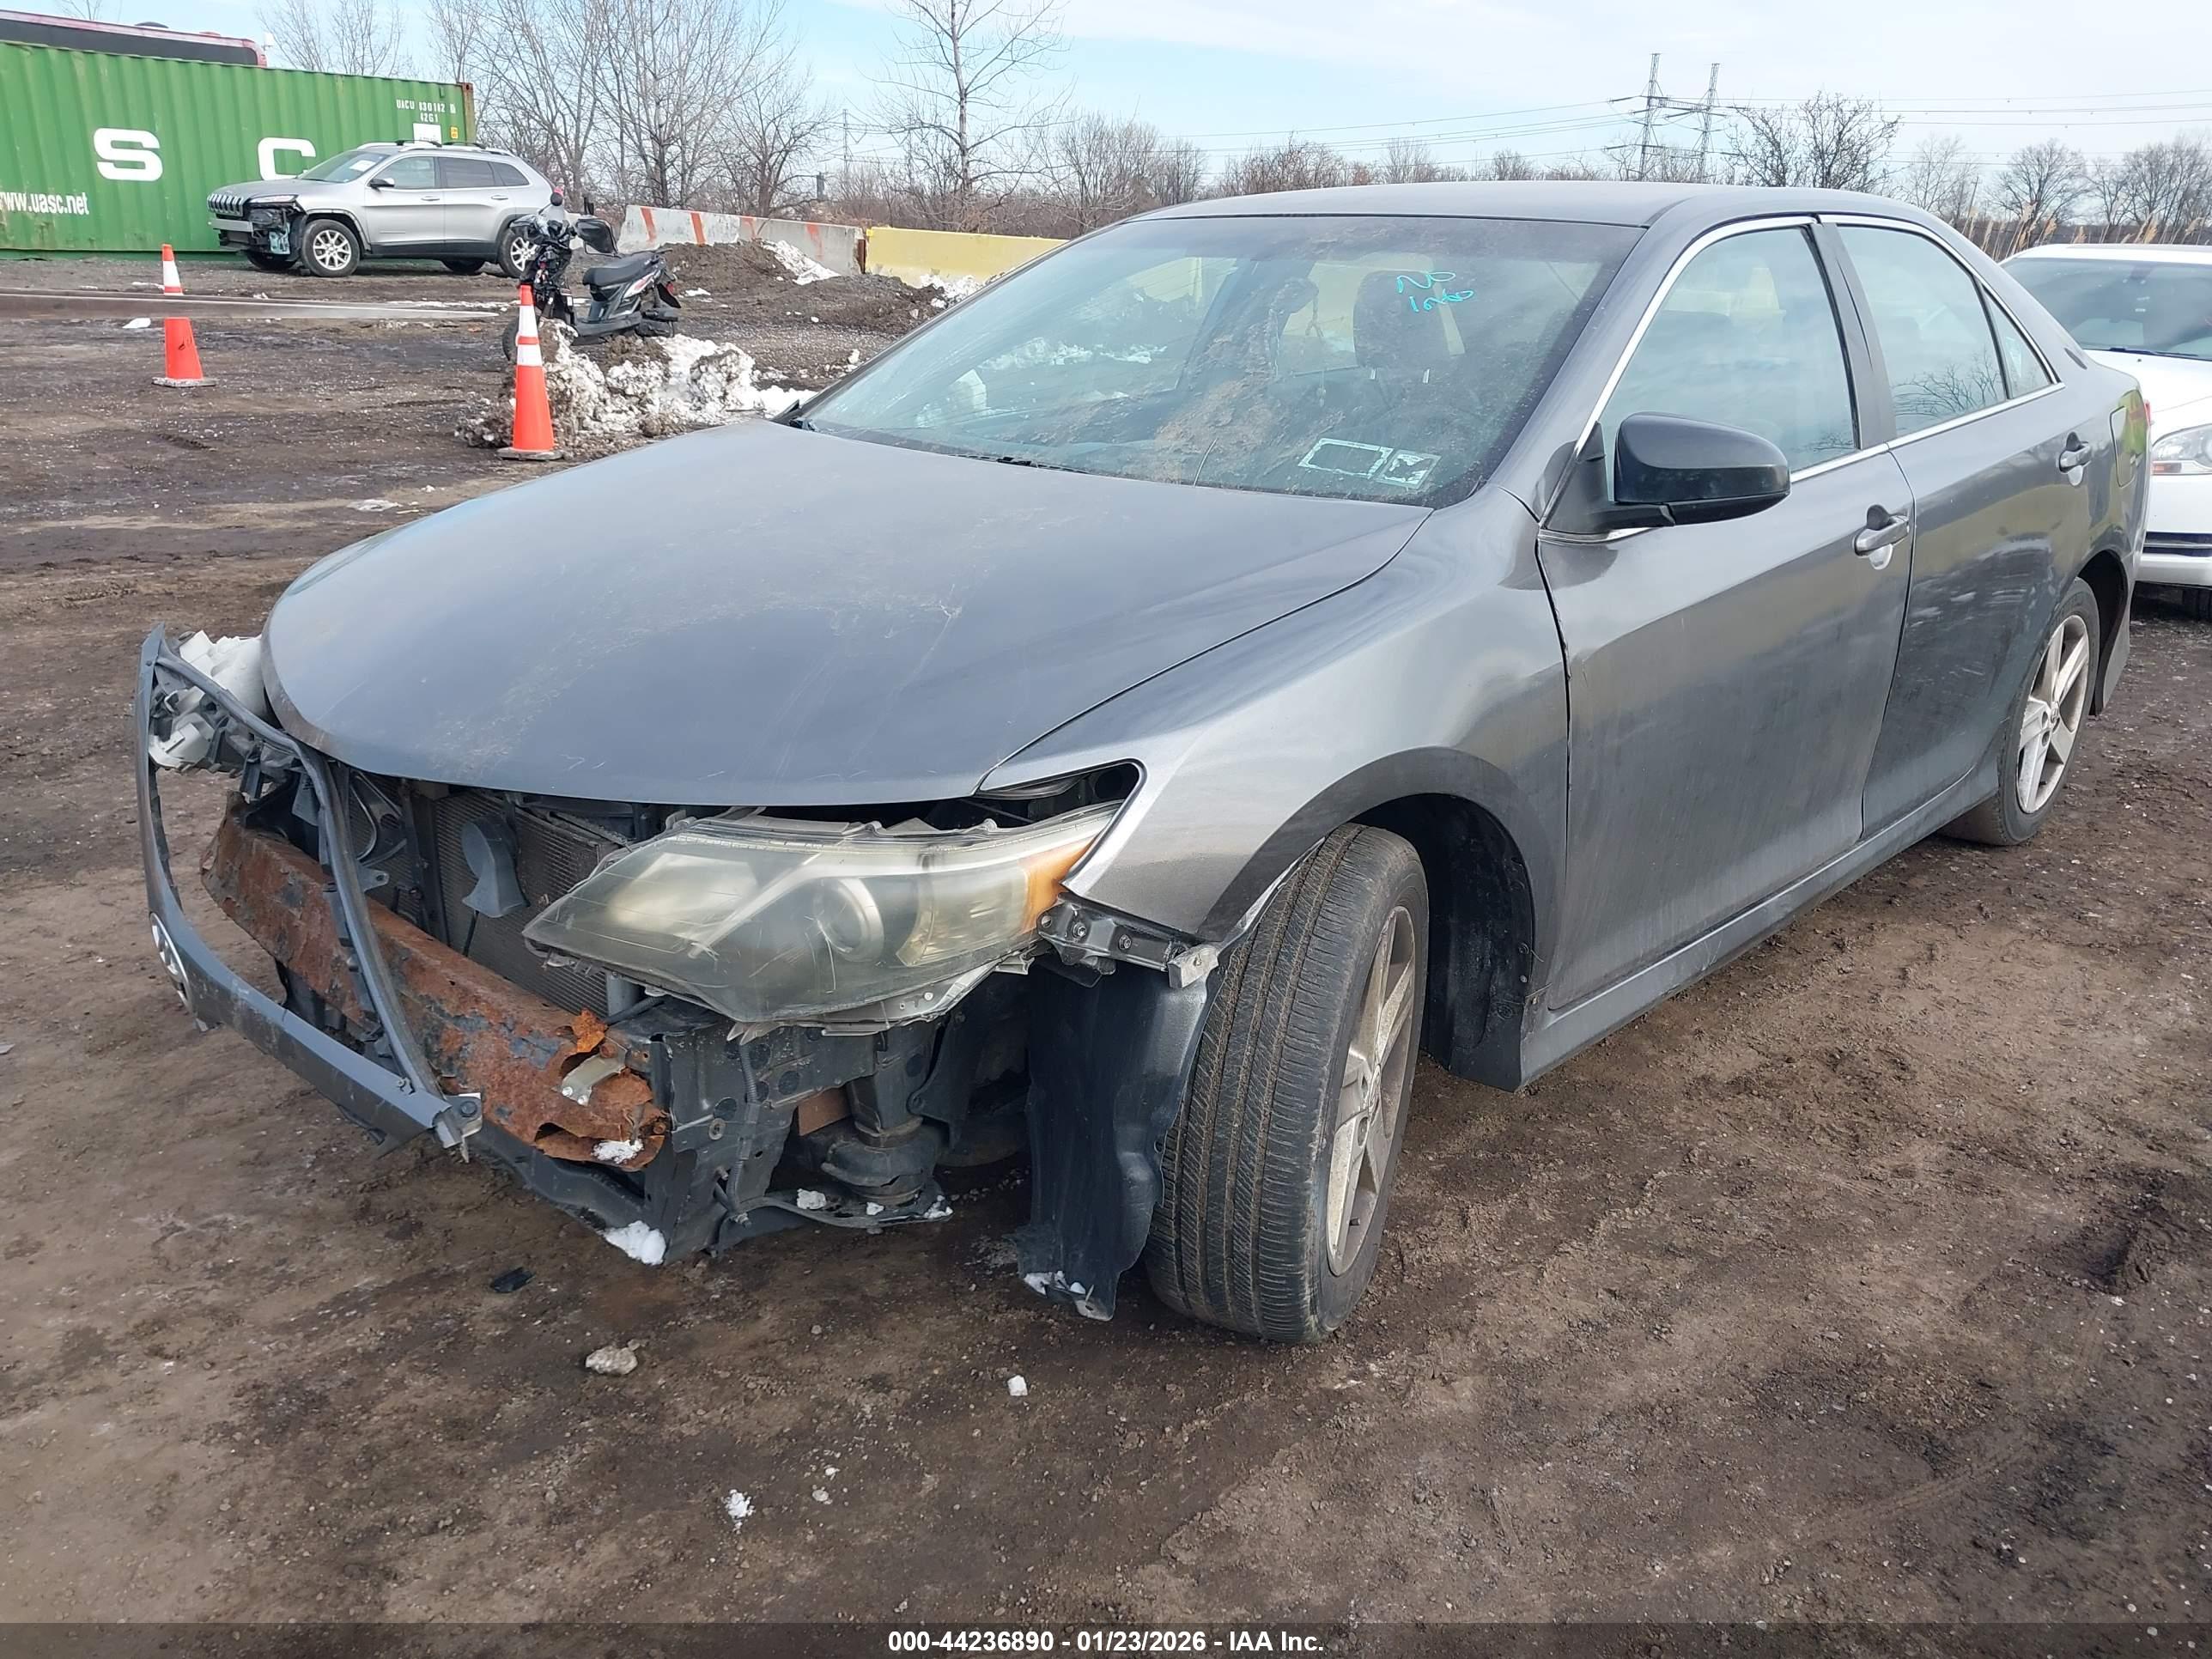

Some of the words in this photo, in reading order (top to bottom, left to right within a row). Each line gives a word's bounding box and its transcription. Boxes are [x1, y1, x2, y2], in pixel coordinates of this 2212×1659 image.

[93, 127, 164, 182] S
[257, 137, 317, 181] C
[0, 191, 89, 215] ww.uasc.net
